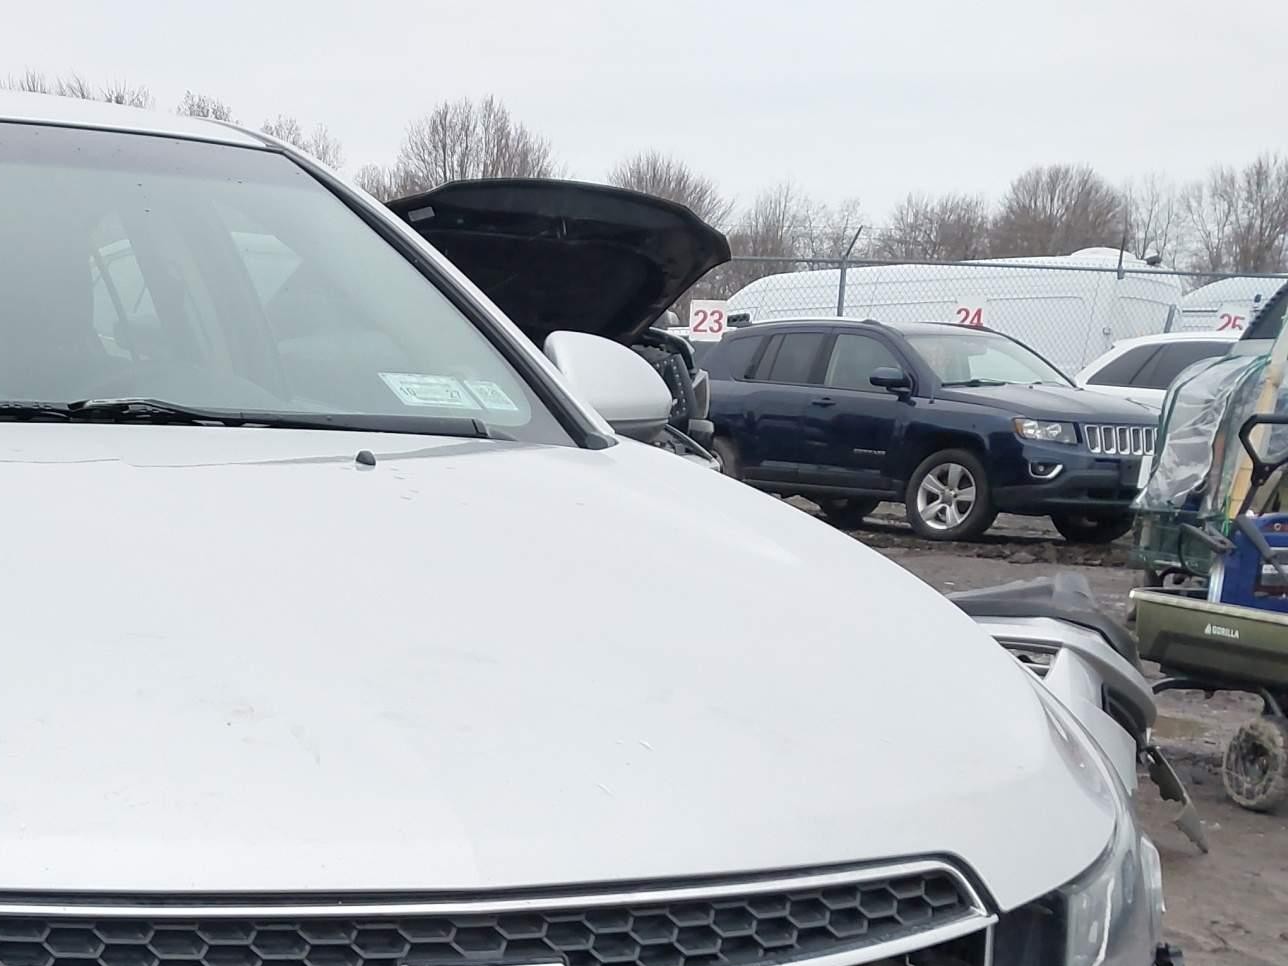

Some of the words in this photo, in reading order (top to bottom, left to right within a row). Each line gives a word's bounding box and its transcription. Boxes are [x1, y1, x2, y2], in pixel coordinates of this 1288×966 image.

[693, 309, 724, 333] 23
[956, 308, 984, 327] 24
[1216, 313, 1246, 331] 25
[1212, 625, 1240, 639] GORILLA
